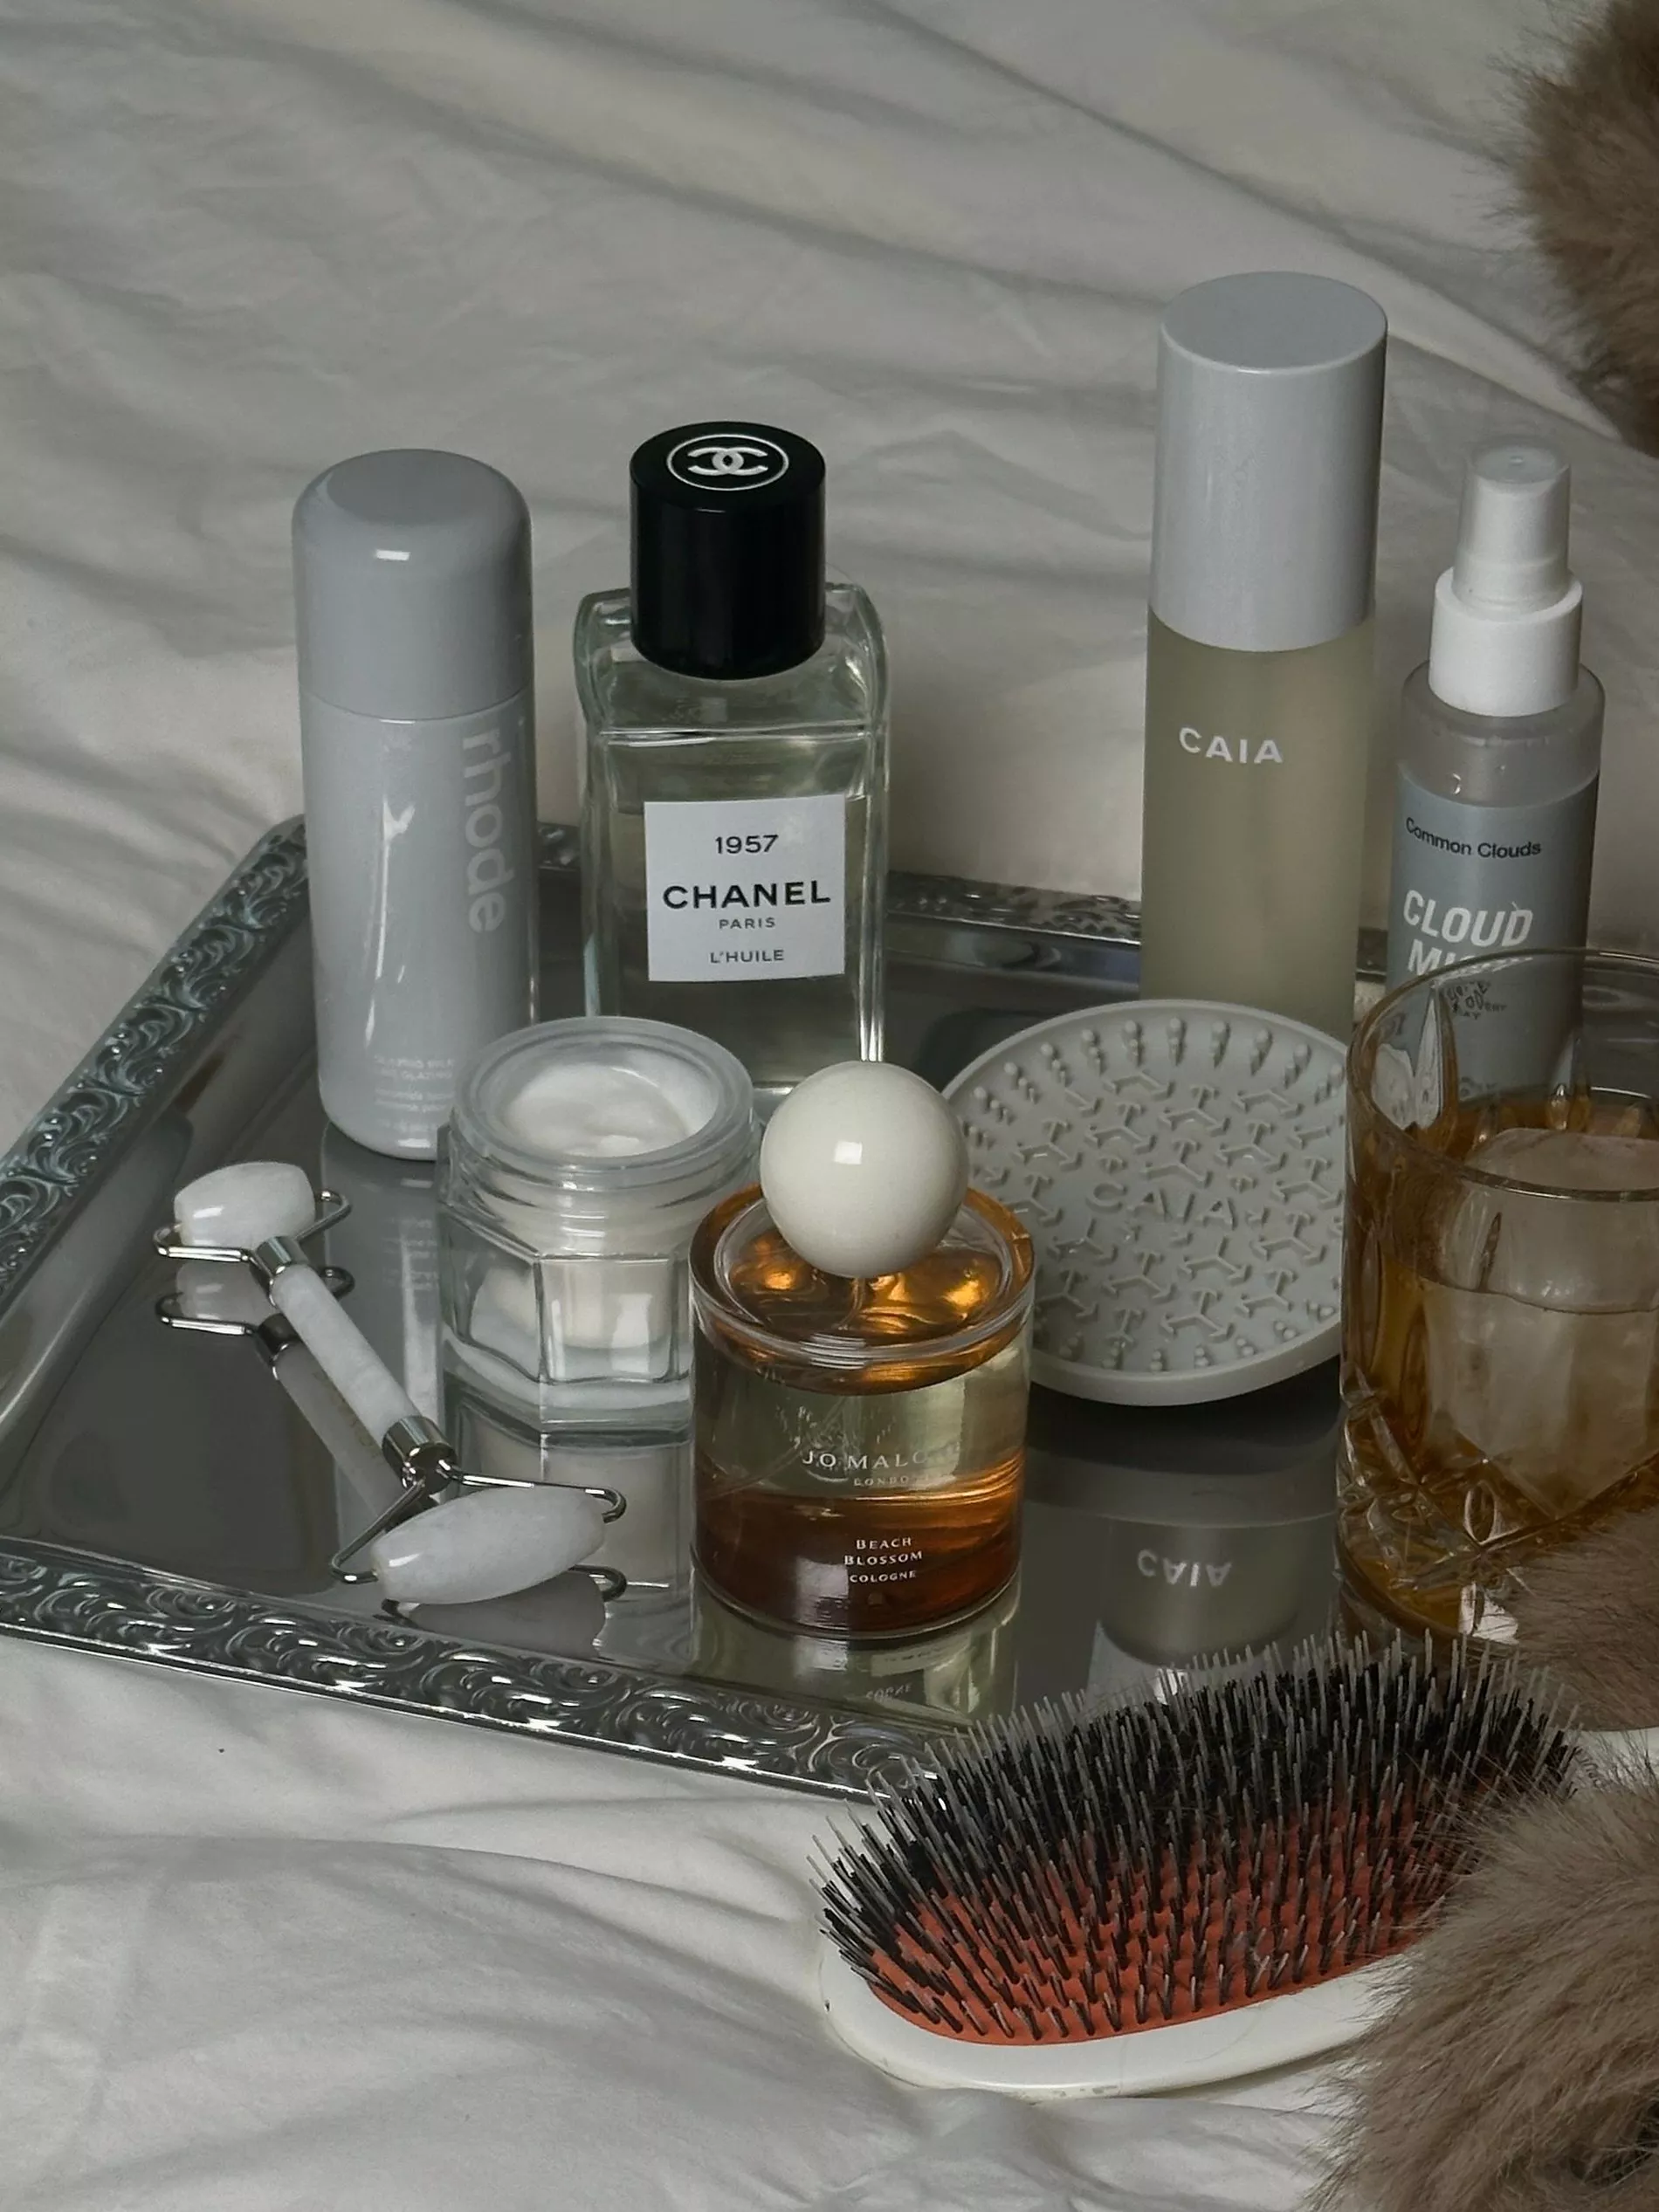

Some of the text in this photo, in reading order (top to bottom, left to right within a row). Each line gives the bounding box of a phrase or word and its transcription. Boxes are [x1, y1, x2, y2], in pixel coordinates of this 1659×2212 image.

[1179, 727, 1283, 763] CAIA
[463, 728, 514, 934] rhode
[1406, 817, 1541, 858] Common Clouds
[715, 835, 779, 854] 1957
[663, 881, 831, 909] CHANEL
[719, 917, 776, 929] PARIS
[1403, 890, 1534, 947] CLOUD
[1086, 1182, 1236, 1228] CAIA
[802, 1451, 836, 1467] JO
[857, 1537, 912, 1549] BEACH
[844, 1550, 923, 1565] BLOSSOM
[850, 1571, 917, 1583] COLOGNE
